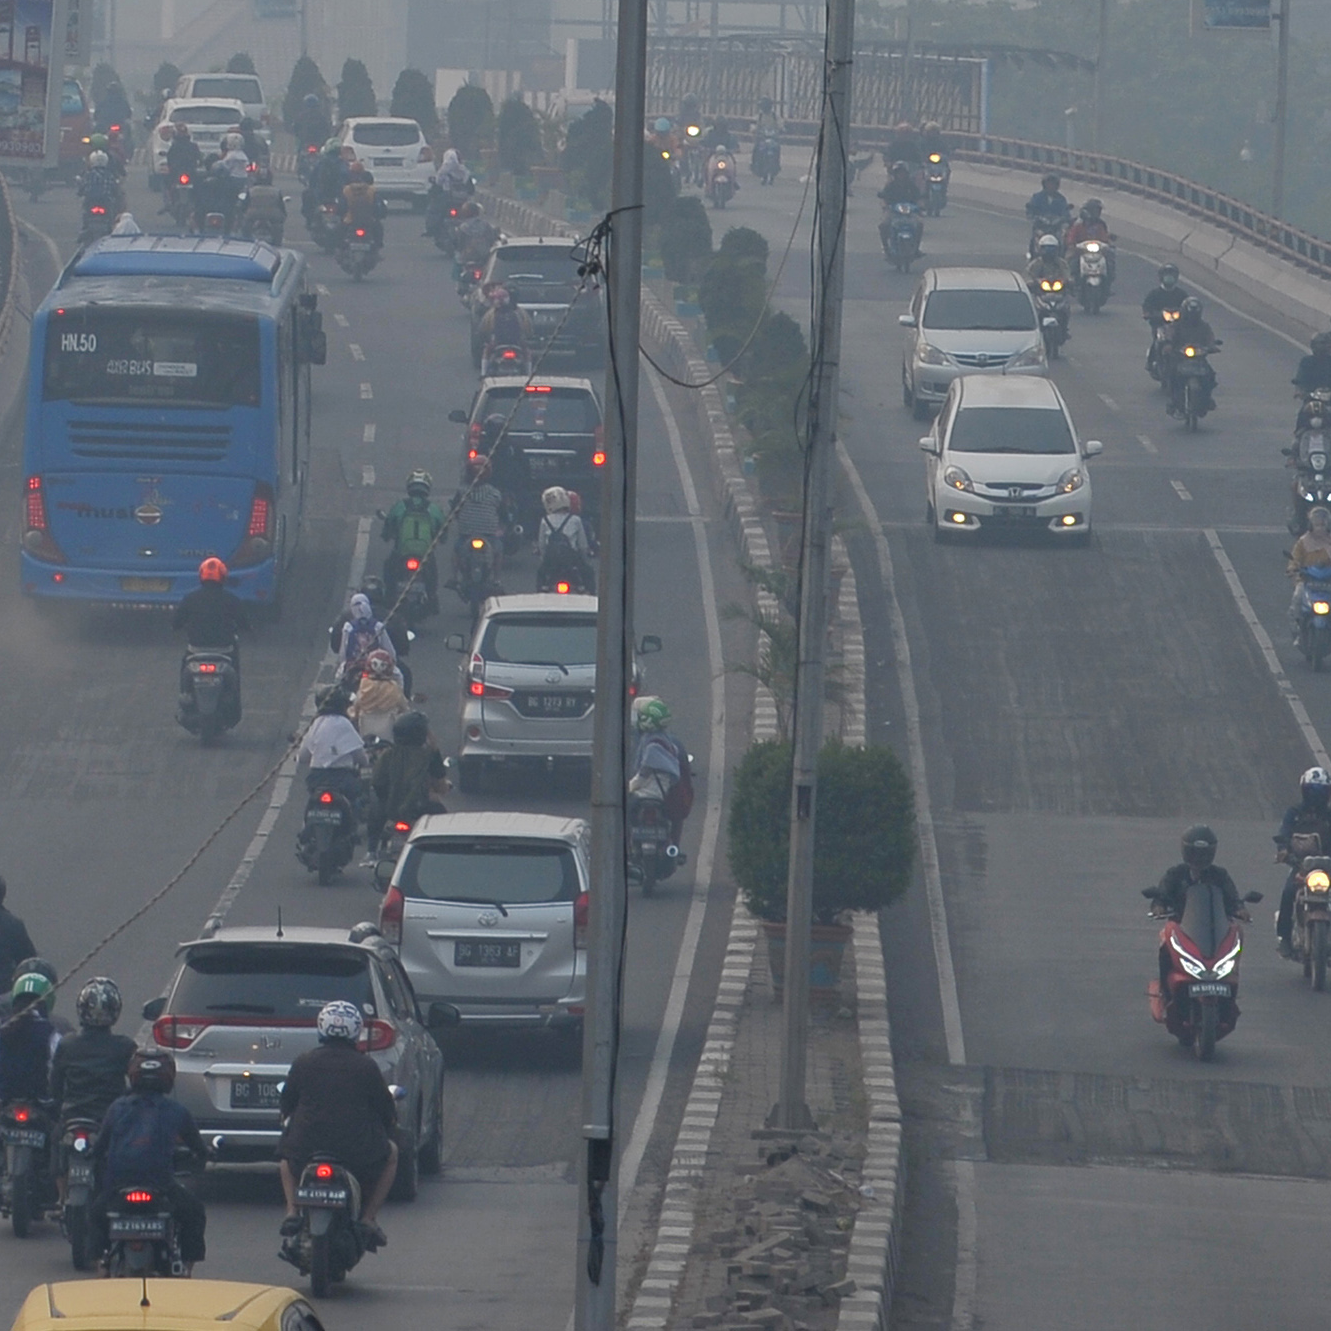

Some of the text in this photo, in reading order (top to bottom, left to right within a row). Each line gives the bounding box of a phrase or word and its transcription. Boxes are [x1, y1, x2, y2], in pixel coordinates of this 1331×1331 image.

[129, 360, 151, 375] BUS
[528, 697, 538, 707] BG
[459, 944, 471, 957] BG
[235, 1083, 281, 1097] BG 108
